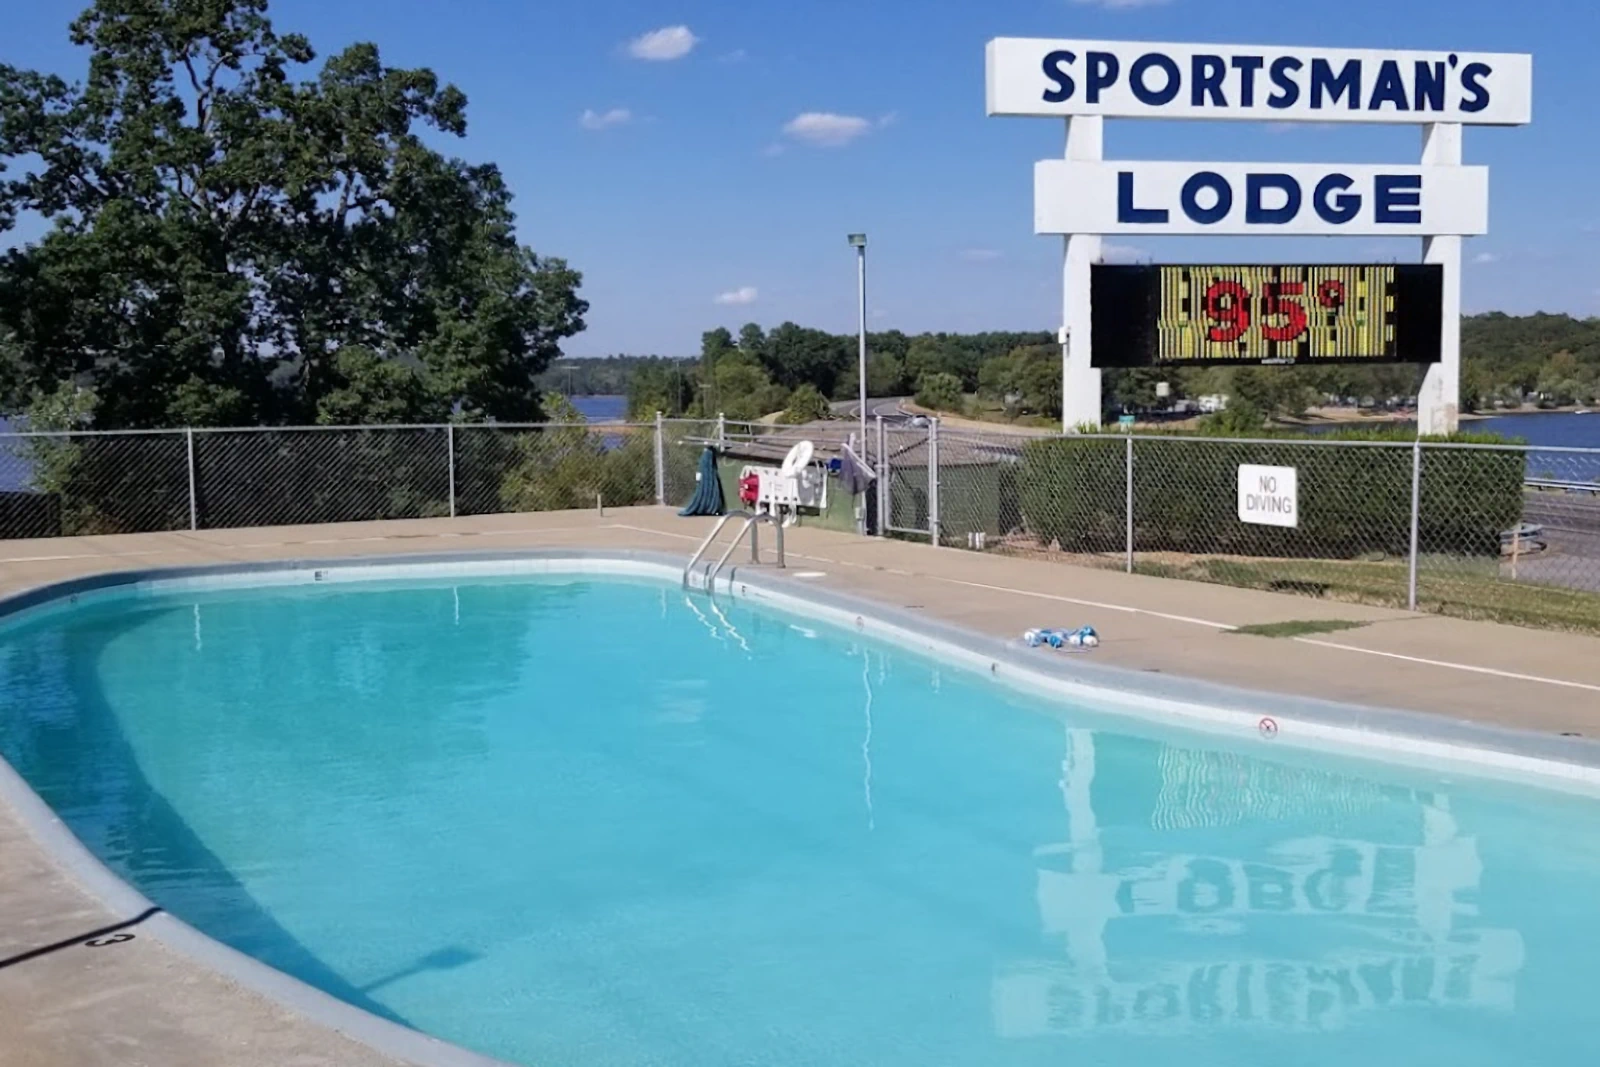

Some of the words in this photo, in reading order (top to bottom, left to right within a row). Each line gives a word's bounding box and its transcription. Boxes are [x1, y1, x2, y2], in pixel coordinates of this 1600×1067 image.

[1042, 50, 1492, 112] SPORTSMAN'S
[1117, 171, 1422, 224] LODGE
[1259, 475, 1277, 493] NO
[1246, 494, 1292, 514] DIVING
